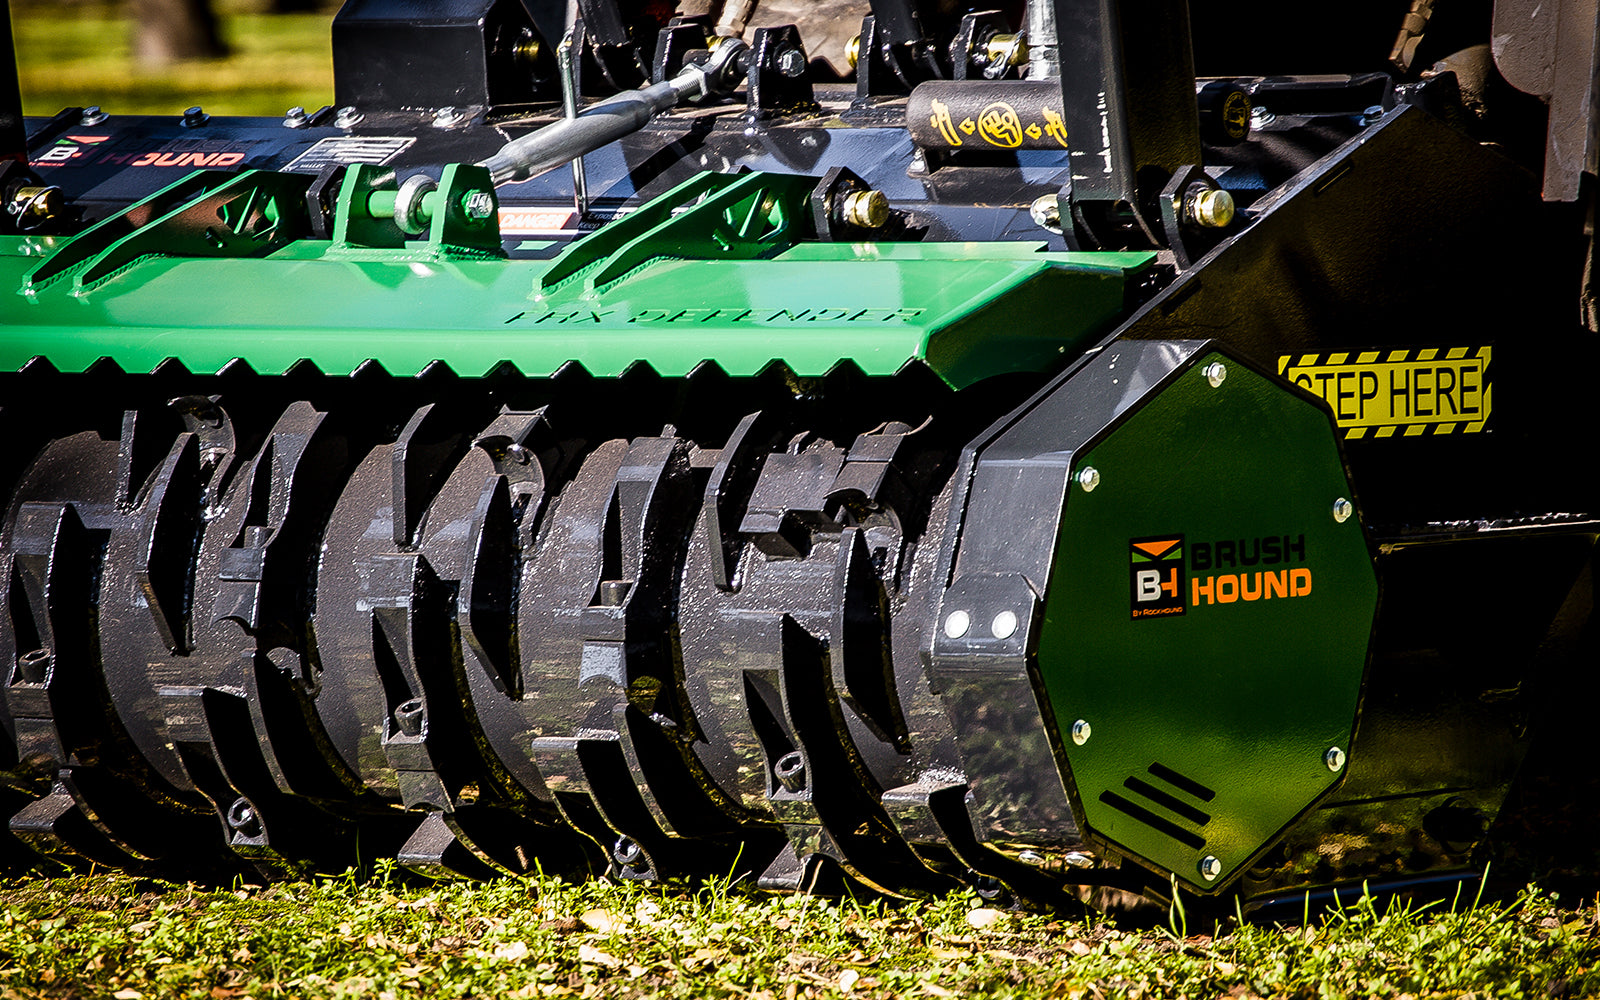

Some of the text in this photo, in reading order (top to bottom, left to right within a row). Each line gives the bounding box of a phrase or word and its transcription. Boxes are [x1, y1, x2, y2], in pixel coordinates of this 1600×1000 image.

[499, 213, 566, 228] DANGER
[627, 307, 927, 323] DEFENDER
[1389, 365, 1479, 418] HERE
[1191, 534, 1305, 571] BRUSH
[1137, 567, 1178, 602] BH
[1191, 568, 1312, 606] HOUND
